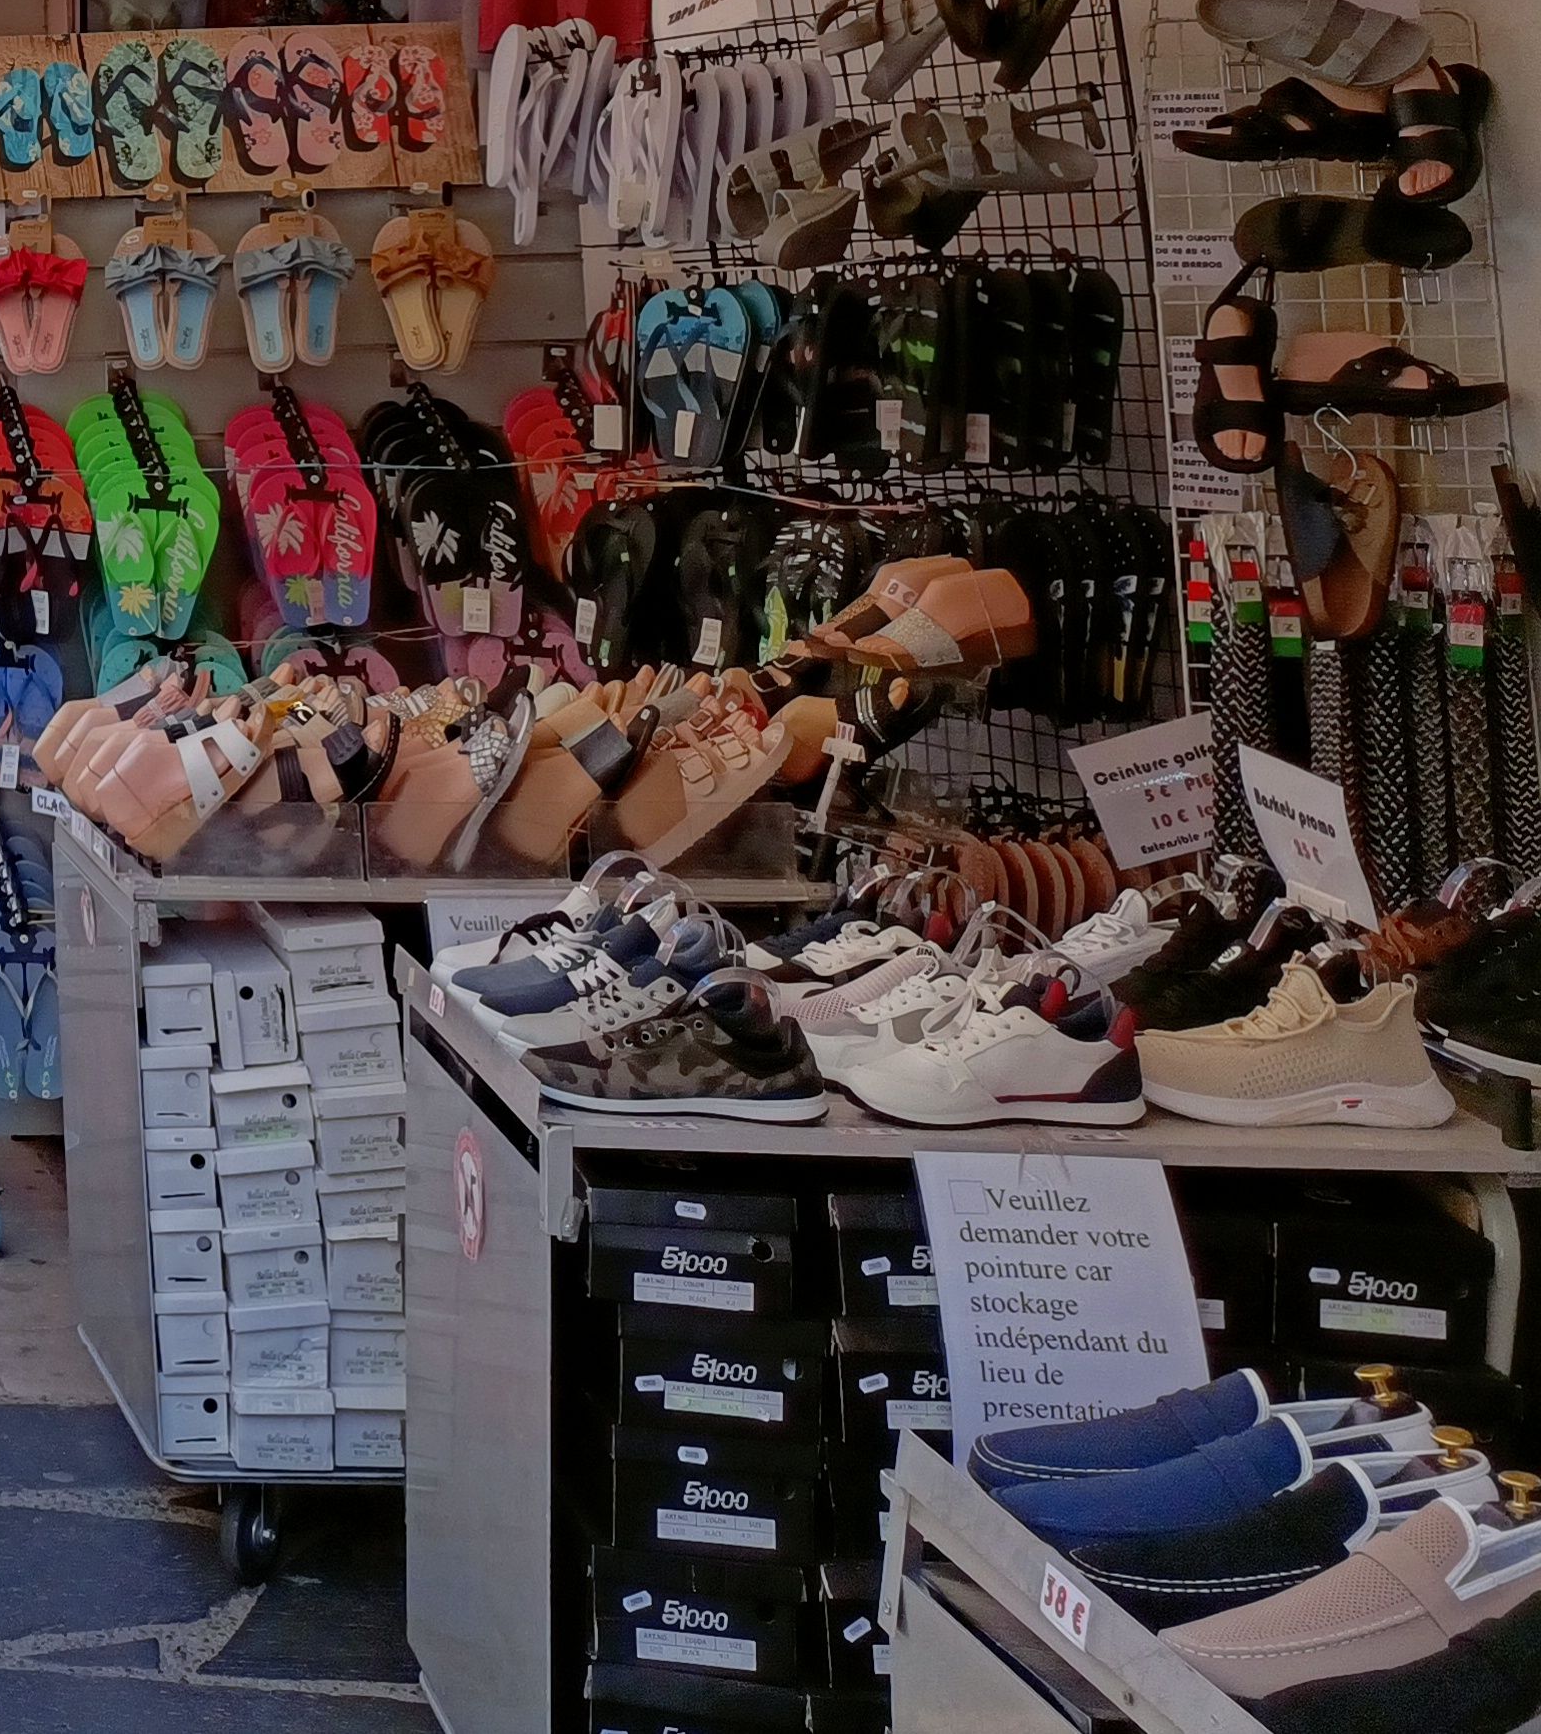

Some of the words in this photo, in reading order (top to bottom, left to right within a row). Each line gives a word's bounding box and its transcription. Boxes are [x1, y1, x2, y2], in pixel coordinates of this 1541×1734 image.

[326, 492, 364, 610] California
[1093, 757, 1169, 786] Ceinture
[1144, 788, 1155, 803] 5
[1151, 813, 1173, 830] 10
[986, 1188, 1091, 1213] Veuillez
[959, 1220, 1078, 1246] demander
[1086, 1228, 1151, 1249] votre
[661, 1245, 728, 1275] 51000
[965, 1255, 1067, 1283] pointure
[1075, 1264, 1113, 1282] car
[1347, 1271, 1418, 1301] 51000
[970, 1291, 1080, 1321] stockage
[974, 1325, 1130, 1356] indépendant
[1137, 1331, 1168, 1355] du
[691, 1353, 757, 1384] 51000
[980, 1360, 1026, 1384] lieu
[1035, 1362, 1065, 1386] de
[983, 1399, 1131, 1423] presentatio
[683, 1480, 749, 1511] 51000
[662, 1599, 729, 1632] 51000
[1044, 1573, 1067, 1619] 38
[1072, 1602, 1085, 1636] €
